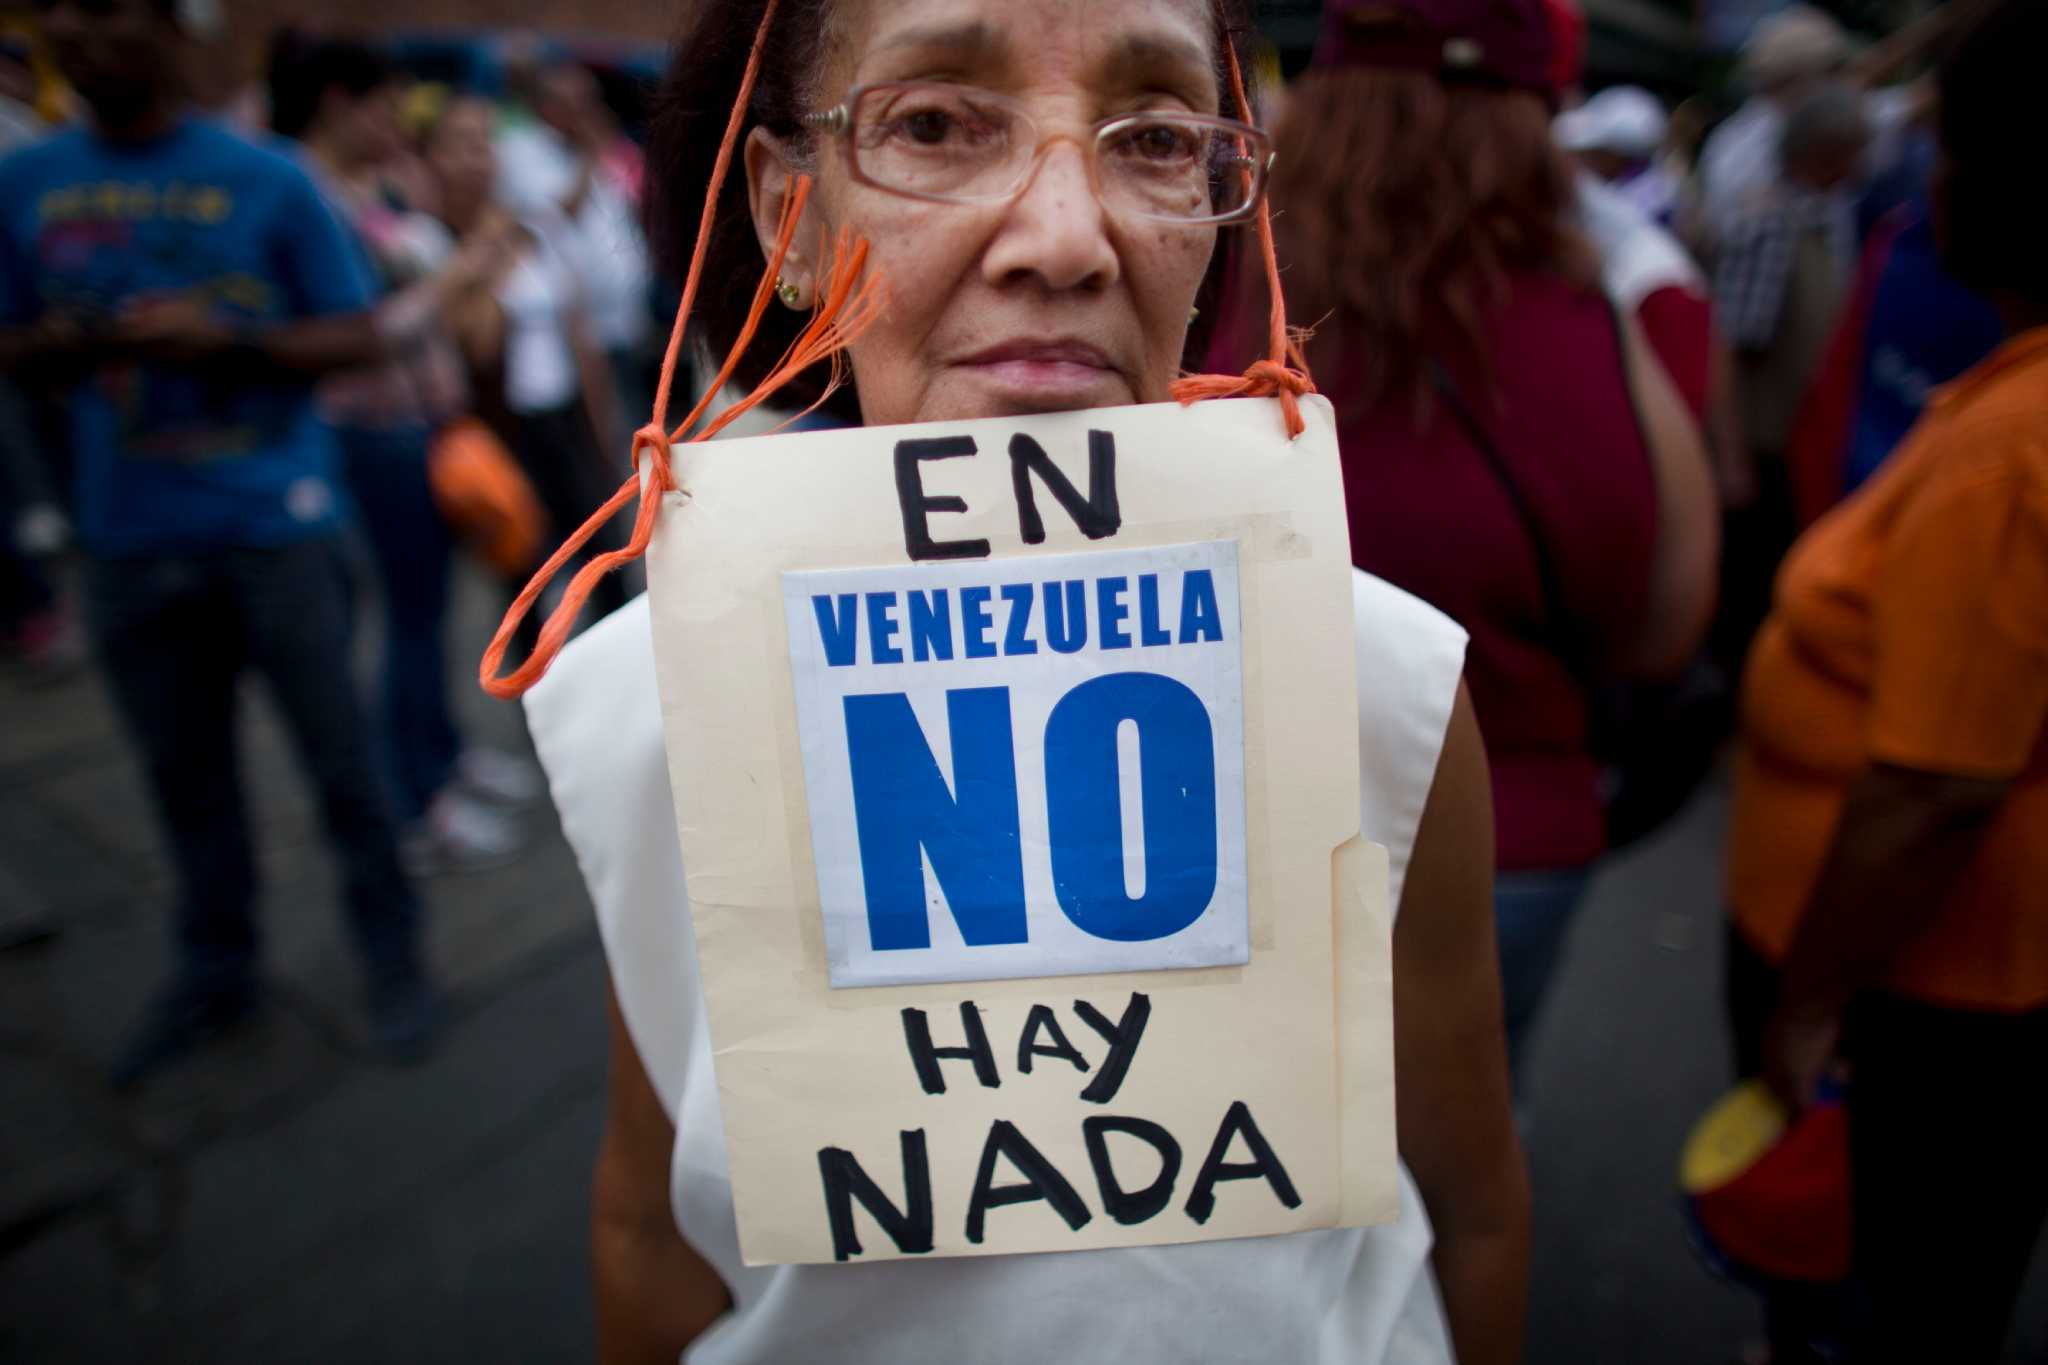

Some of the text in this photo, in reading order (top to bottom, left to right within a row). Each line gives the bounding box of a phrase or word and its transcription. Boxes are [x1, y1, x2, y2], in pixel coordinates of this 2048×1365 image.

[895, 430, 1121, 561] EN
[811, 569, 1223, 667] VENEZUELA
[842, 672, 1217, 952] NO
[901, 992, 1151, 1103] HAY
[818, 1101, 1302, 1261] NADA
